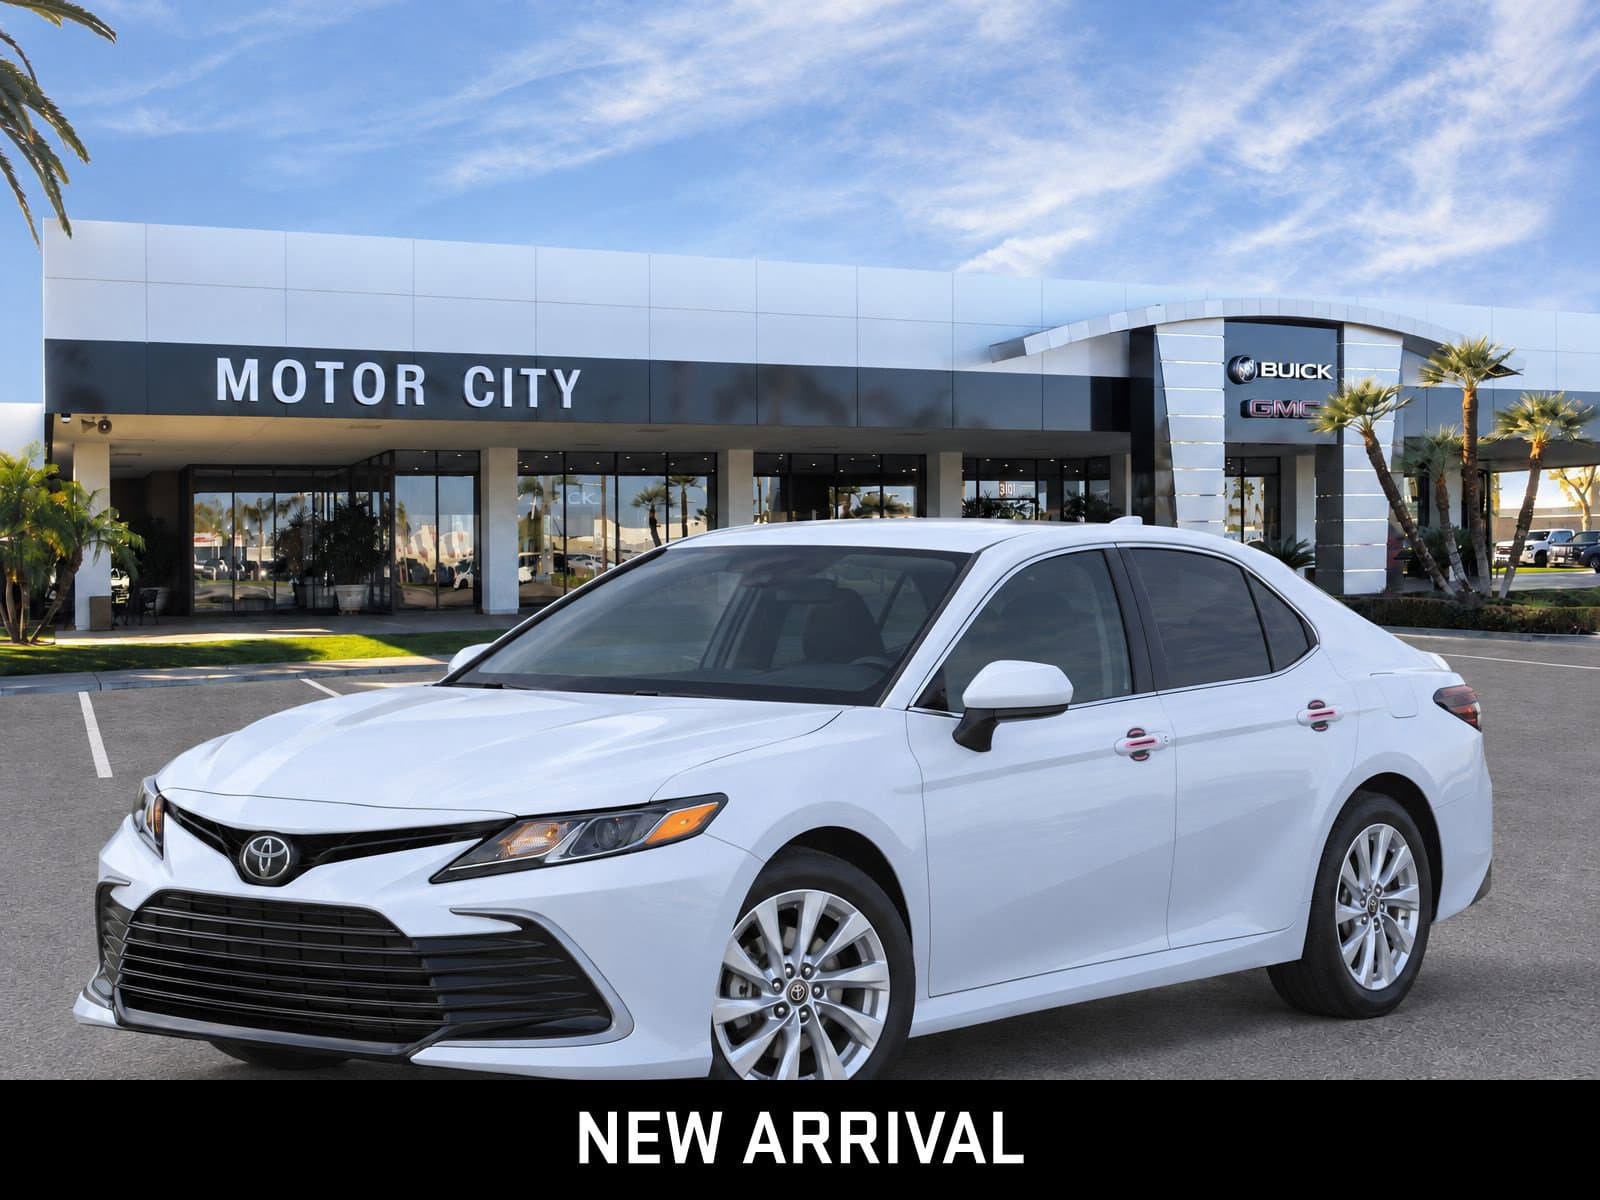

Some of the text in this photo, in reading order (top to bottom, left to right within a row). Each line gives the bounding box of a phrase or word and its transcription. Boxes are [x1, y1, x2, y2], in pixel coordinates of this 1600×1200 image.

[1261, 362, 1333, 379] BUICK
[216, 357, 582, 409] MOTOR CITY
[1249, 399, 1321, 418] GMC
